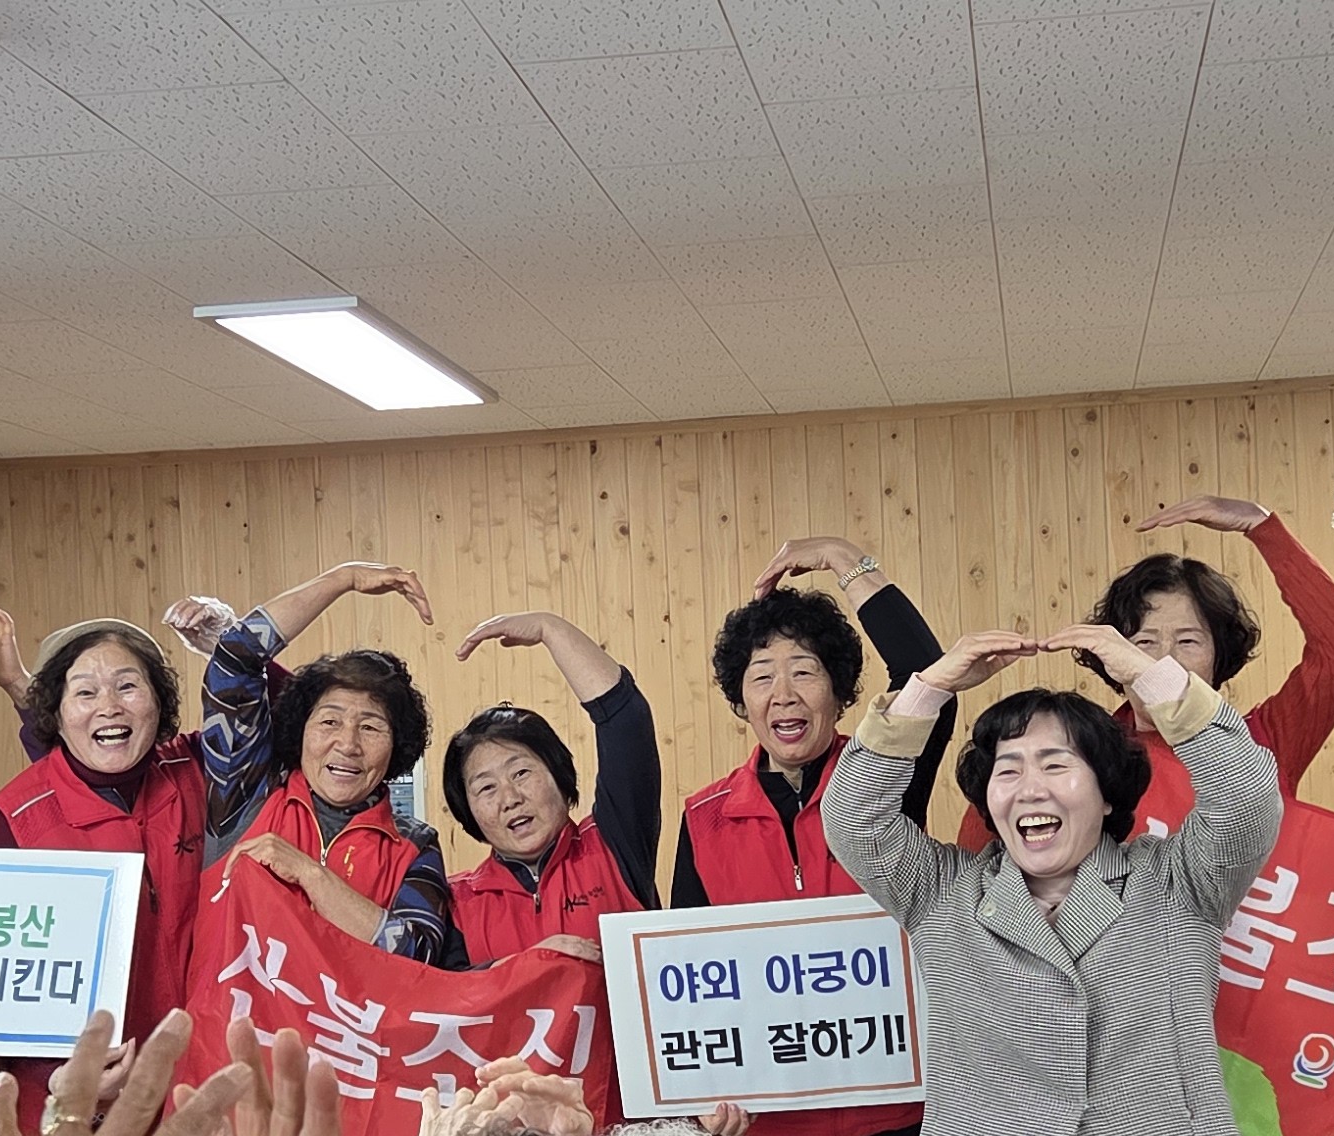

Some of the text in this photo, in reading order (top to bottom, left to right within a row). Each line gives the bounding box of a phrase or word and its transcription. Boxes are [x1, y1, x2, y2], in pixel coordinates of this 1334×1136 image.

[659, 946, 890, 1003] 야외 아궁이
[660, 1014, 907, 1071] 관리 잘하기!
